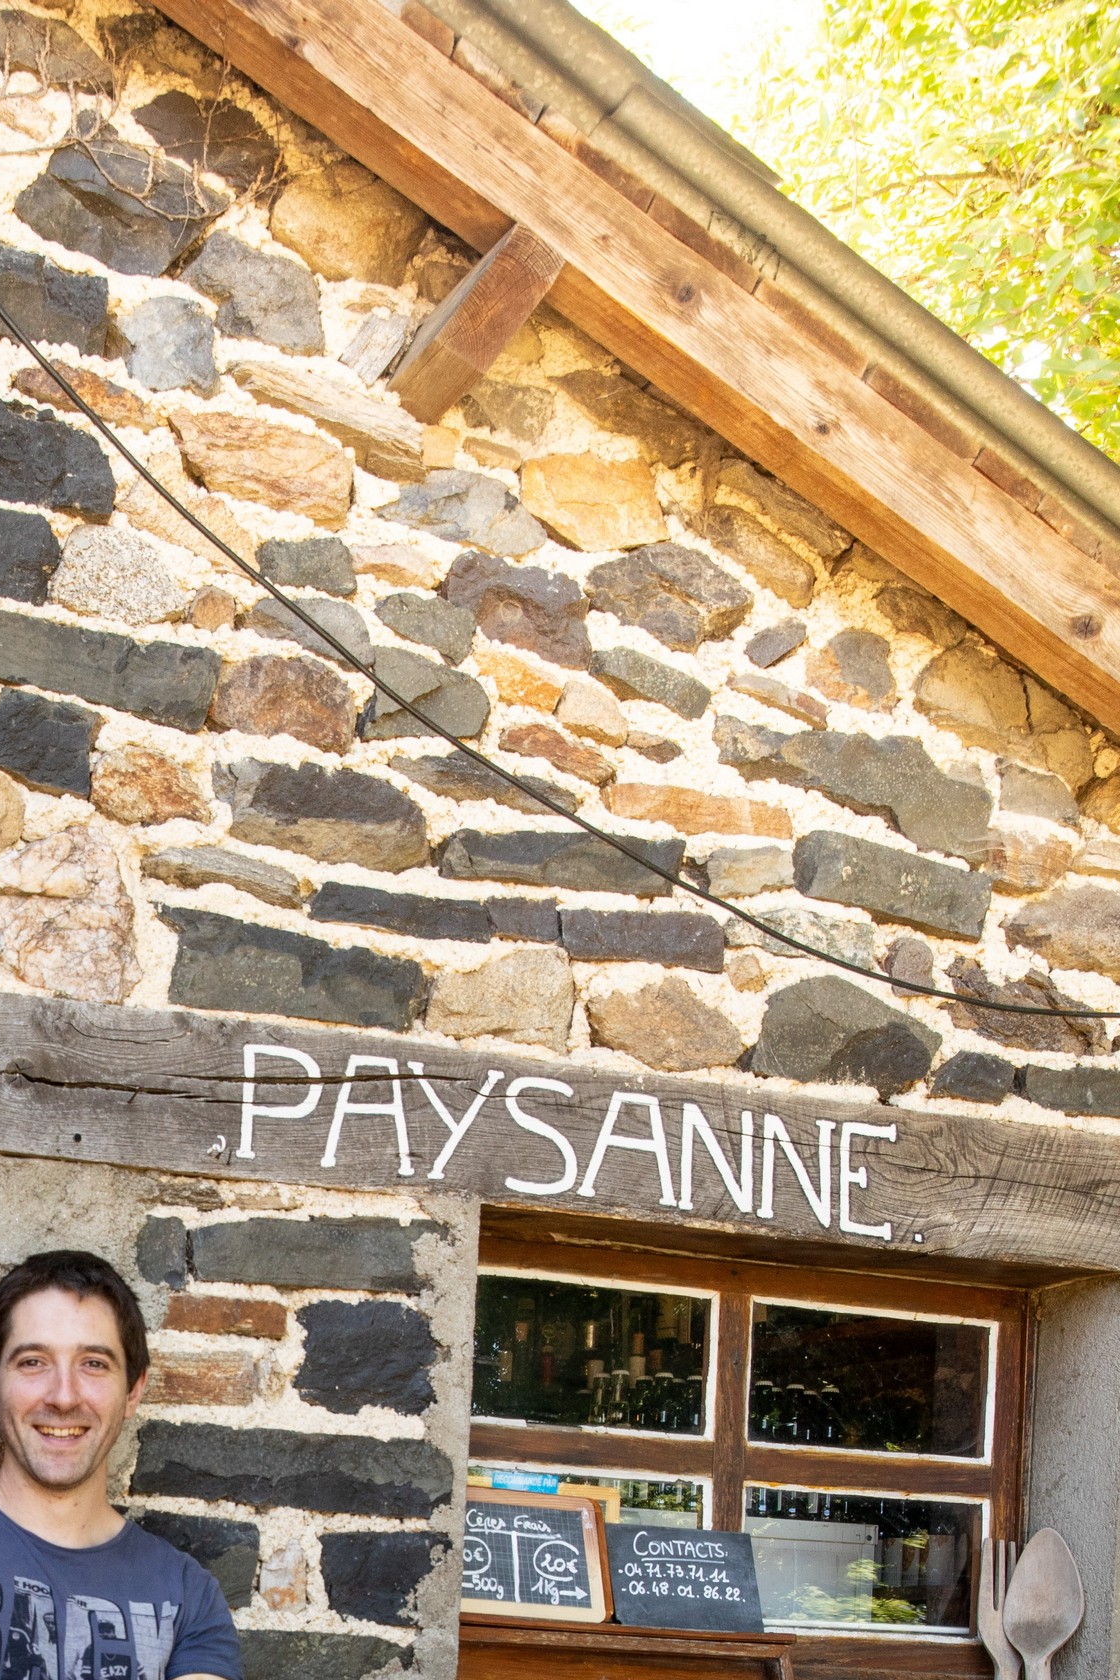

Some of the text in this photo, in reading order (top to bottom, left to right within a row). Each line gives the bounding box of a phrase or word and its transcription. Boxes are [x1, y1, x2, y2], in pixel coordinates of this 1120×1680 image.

[463, 1547, 578, 1574] 0€ 20€
[99, 1664, 129, 1678] EAZY
